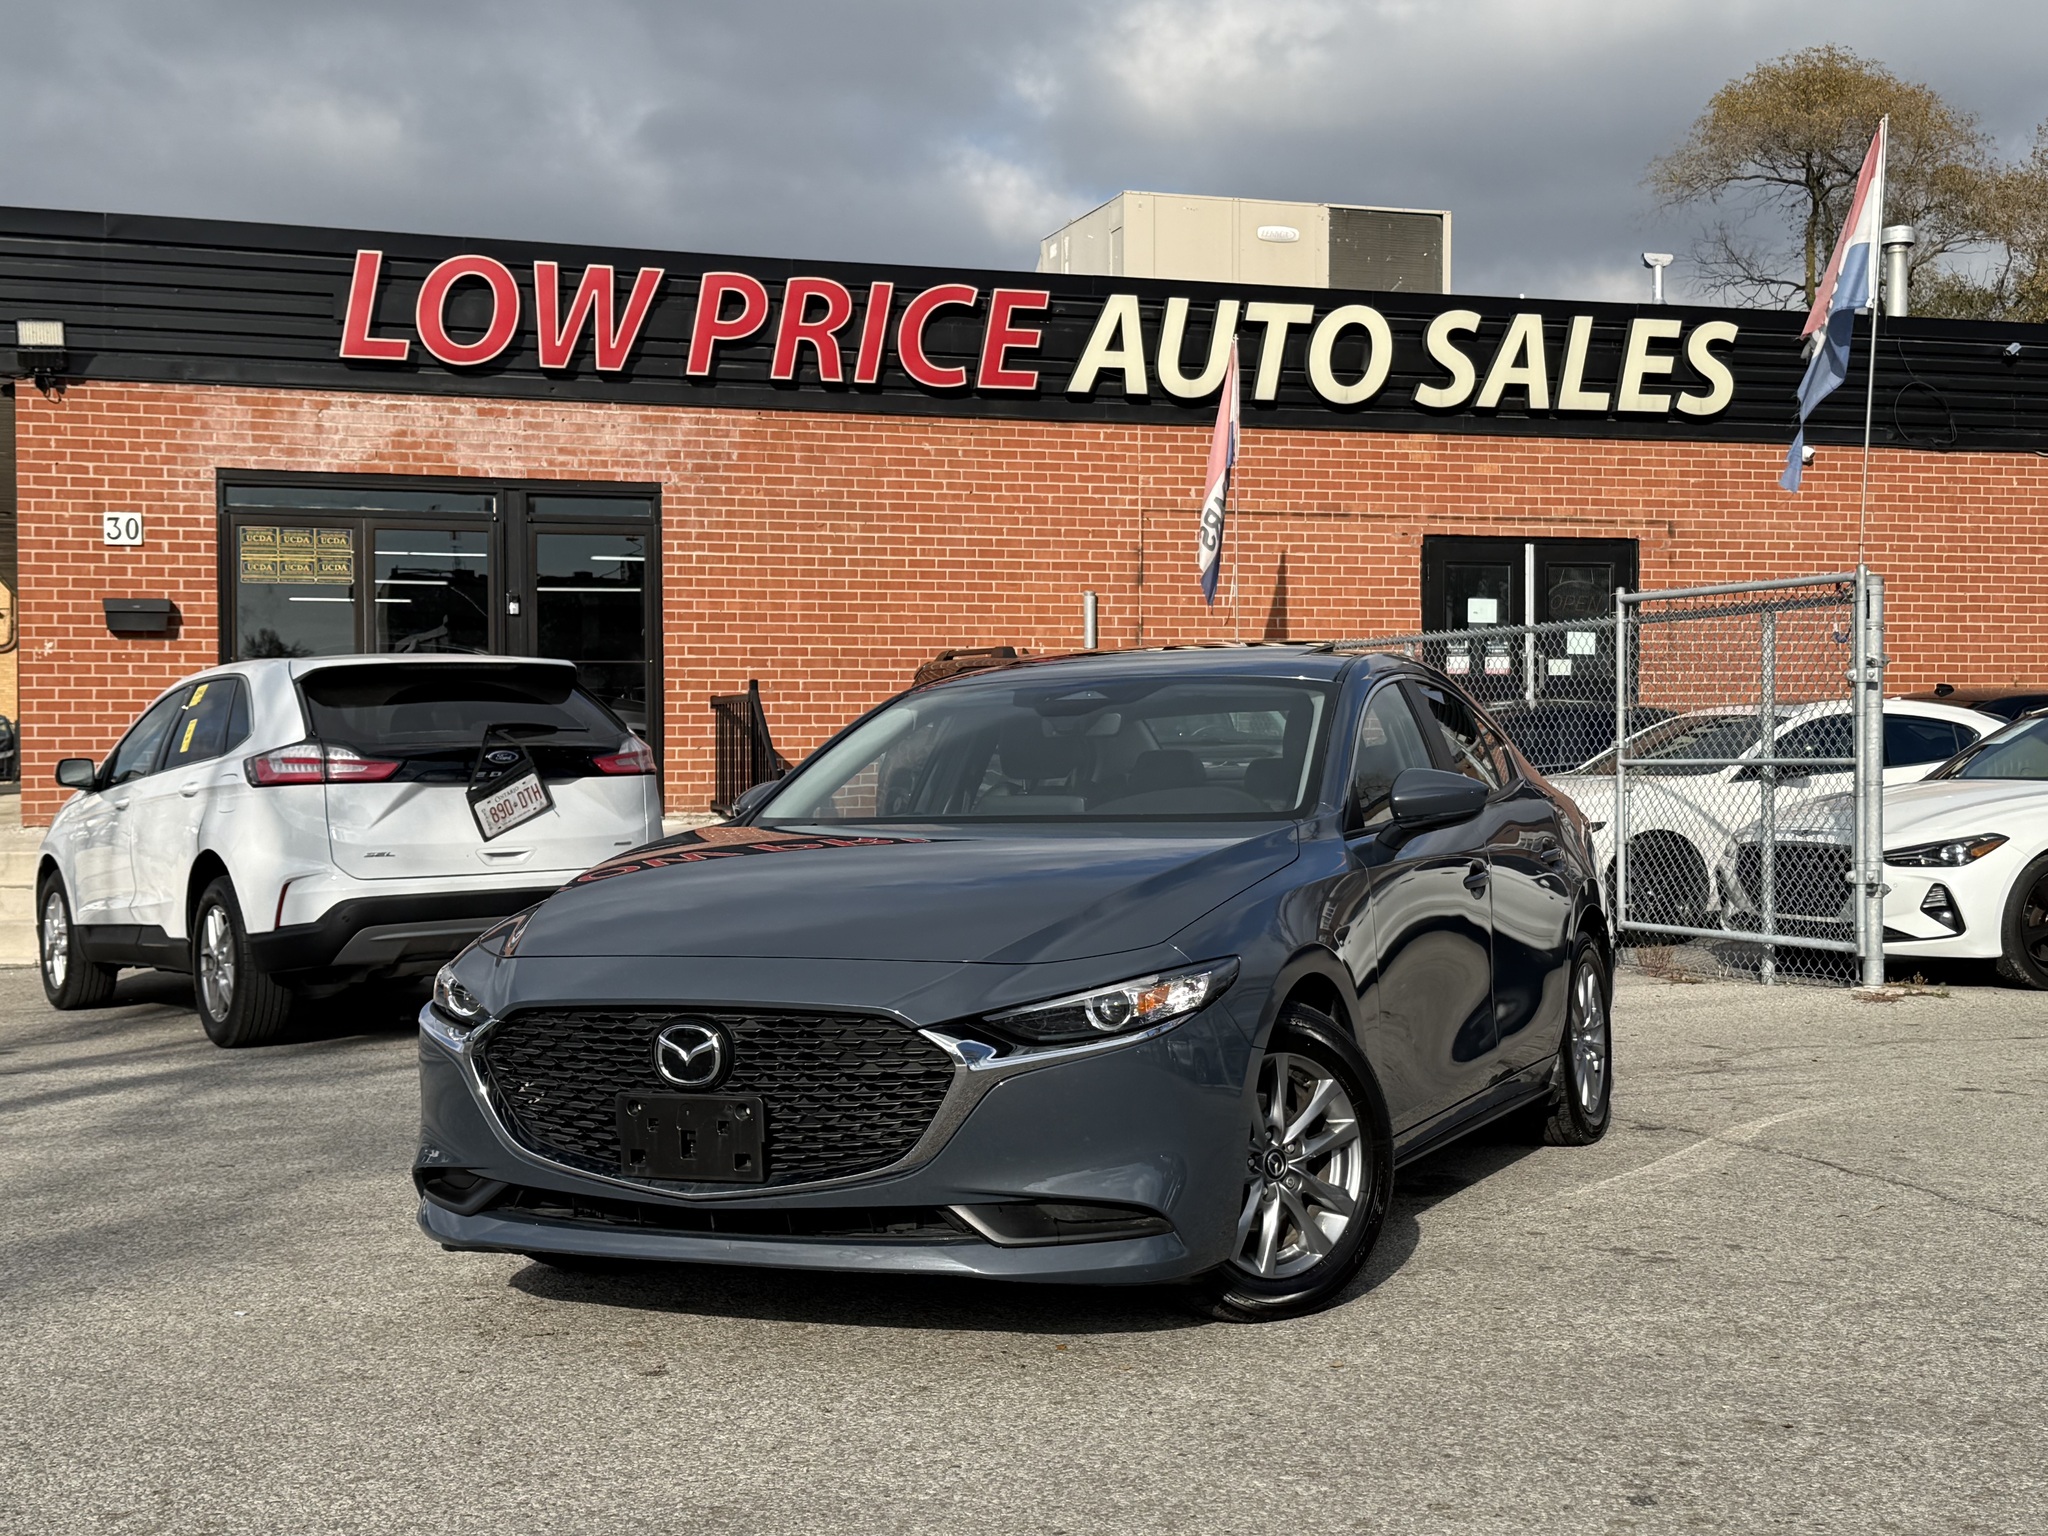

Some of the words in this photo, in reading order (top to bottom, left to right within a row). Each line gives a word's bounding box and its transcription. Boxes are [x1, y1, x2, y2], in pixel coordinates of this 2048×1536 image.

[339, 249, 665, 371] LOW
[686, 272, 1050, 390] PRICE
[1066, 294, 1393, 404] AUTO
[1414, 309, 1739, 416] SALES
[106, 516, 139, 540] 30
[246, 534, 273, 543] UCDA
[283, 535, 310, 544] UCDA
[320, 536, 347, 545] UCDA
[247, 563, 273, 571] UCDA
[284, 563, 310, 572] UCDA
[321, 563, 348, 571] UCDA
[1550, 594, 1603, 612] OPEN
[516, 783, 543, 809] DTH
